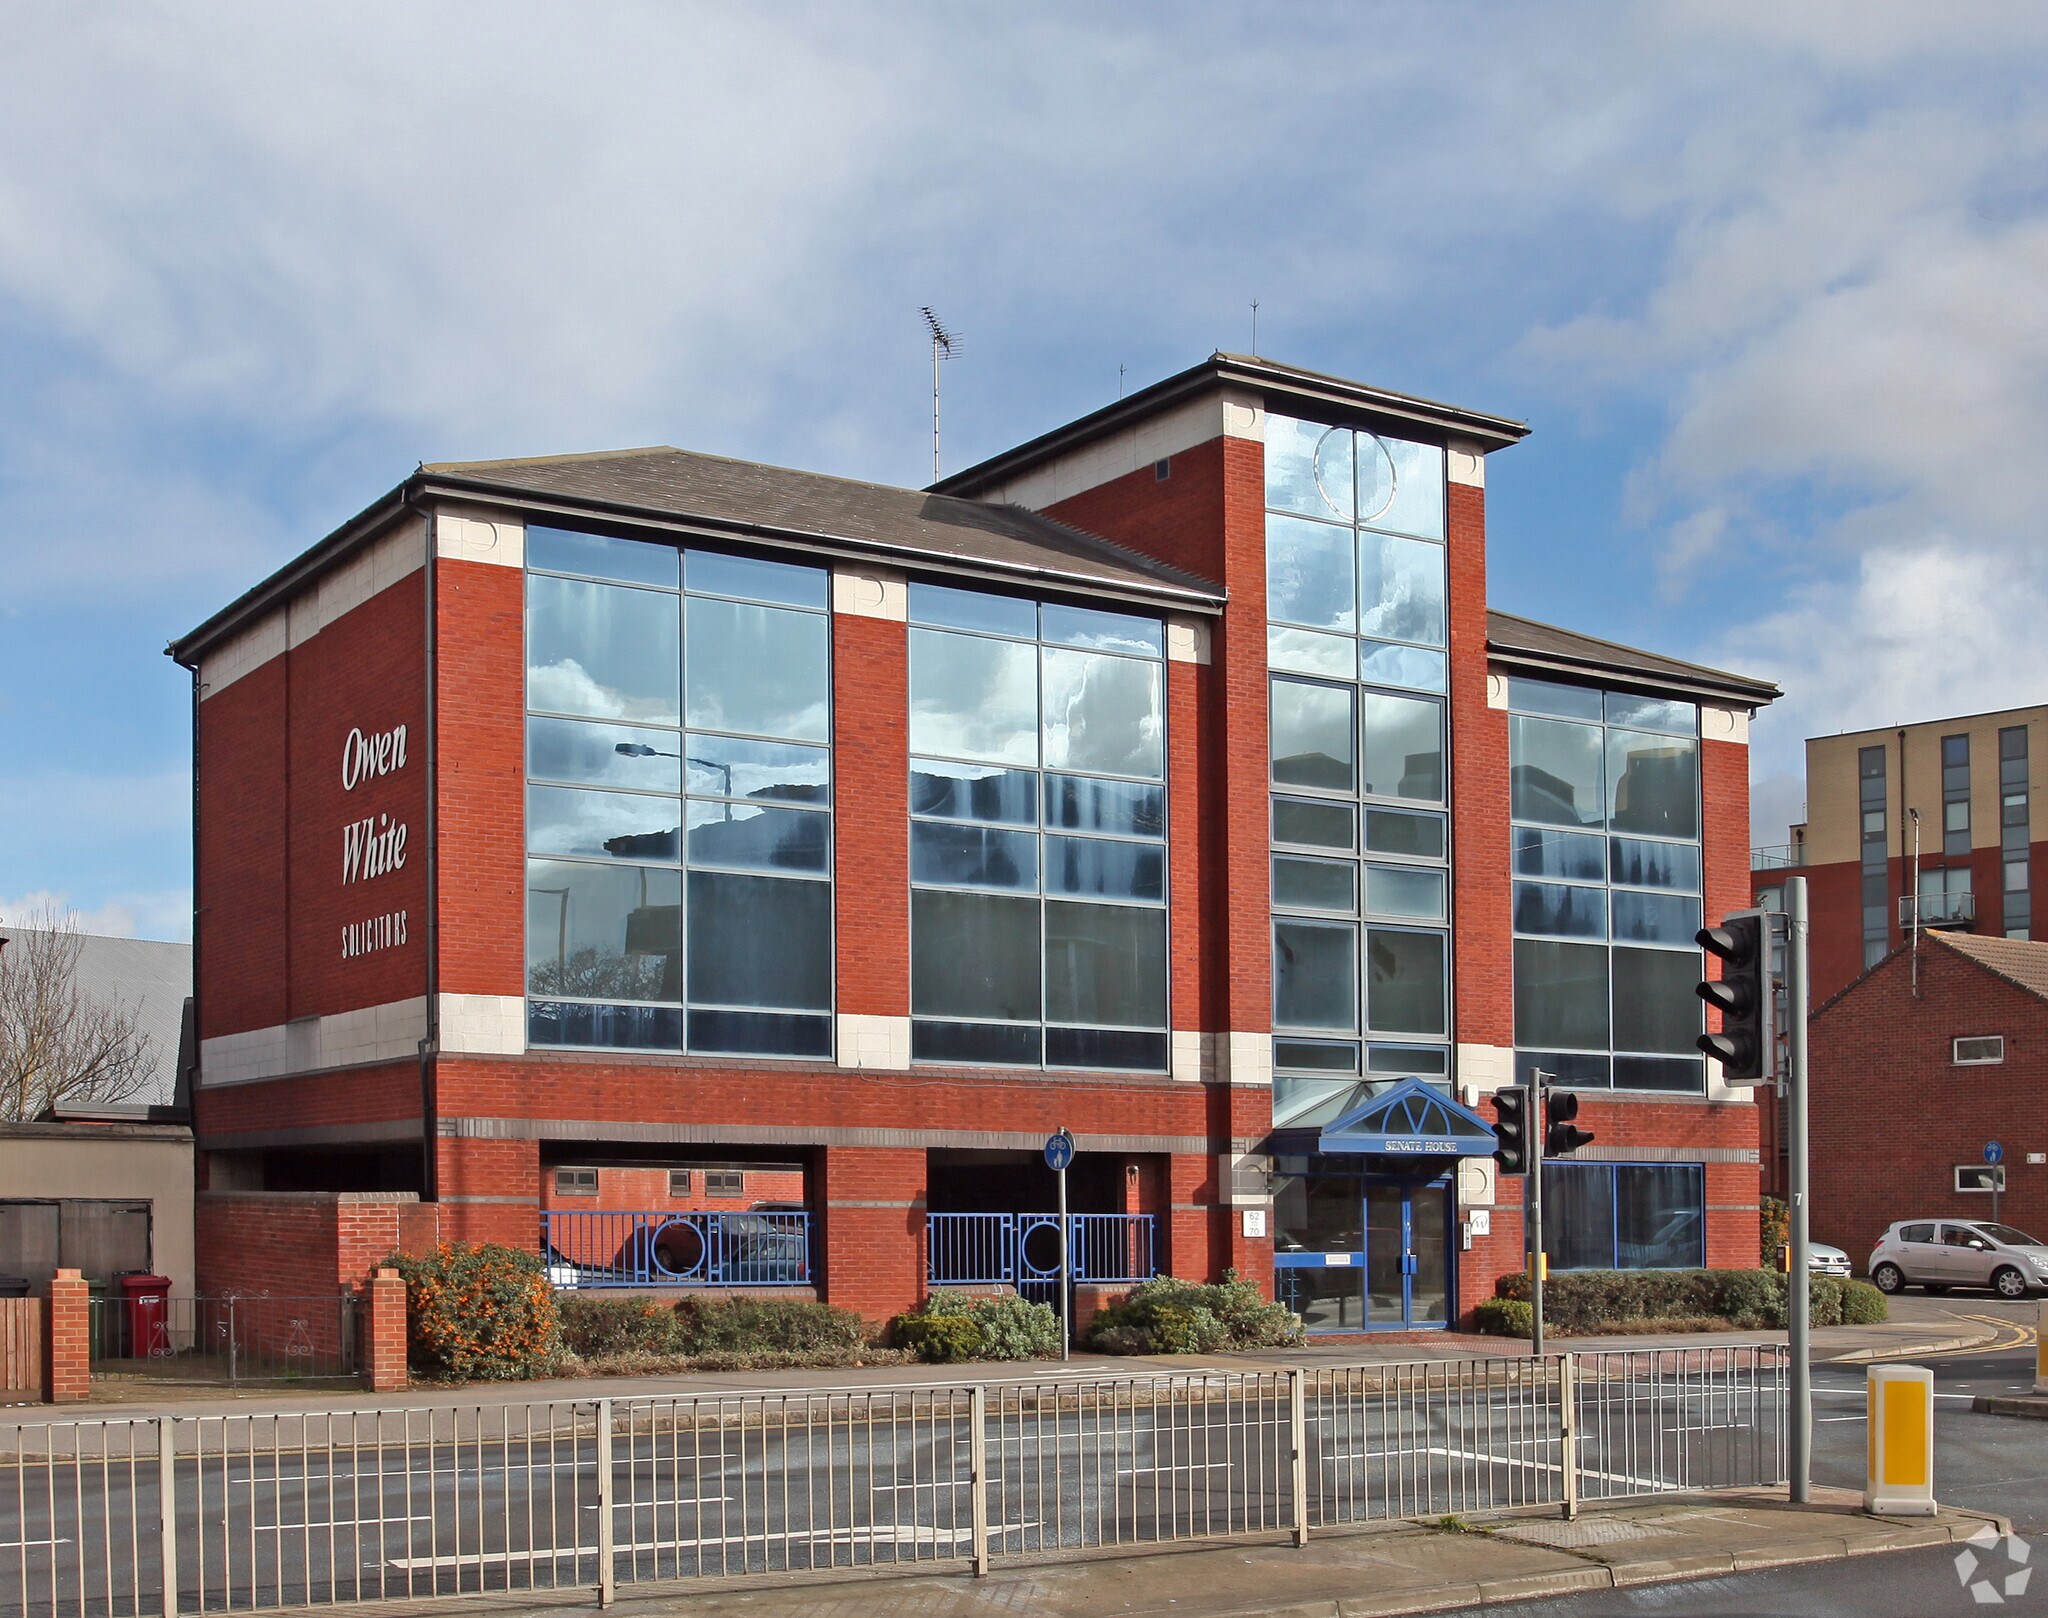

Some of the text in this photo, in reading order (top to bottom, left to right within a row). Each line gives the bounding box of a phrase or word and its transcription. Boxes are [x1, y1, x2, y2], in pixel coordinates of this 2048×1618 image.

[341, 723, 407, 791] Owen
[342, 813, 407, 885] White
[341, 910, 407, 959] SOLICITORS
[1385, 1140, 1457, 1152] SENATE HOUSE
[1794, 1192, 1802, 1205] 7
[1249, 1212, 1260, 1220] 62
